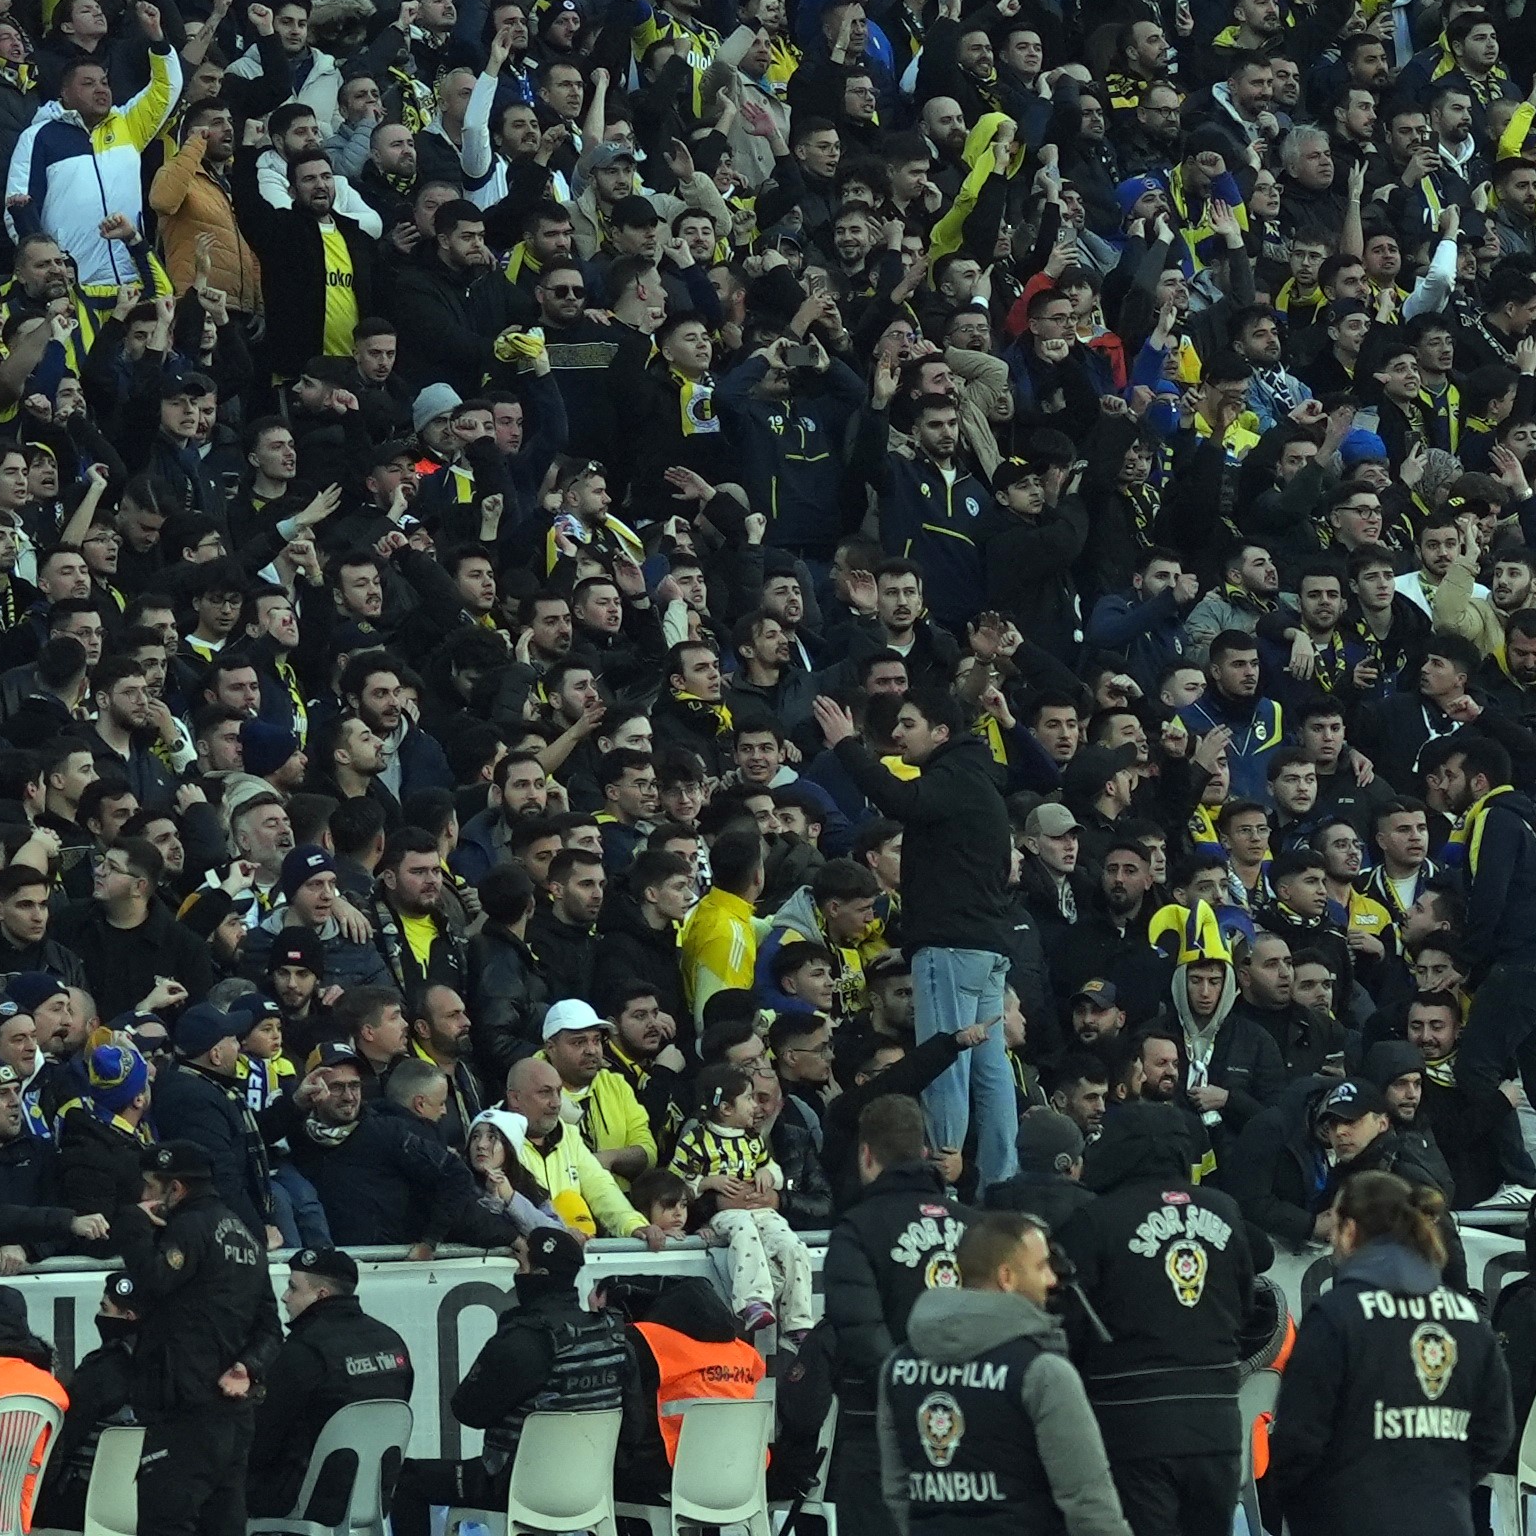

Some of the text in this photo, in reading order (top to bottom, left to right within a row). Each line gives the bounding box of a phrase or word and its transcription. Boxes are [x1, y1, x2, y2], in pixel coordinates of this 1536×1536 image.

[889, 1216, 944, 1269] SPOR
[1127, 1204, 1234, 1259] SPOR ŞUBE
[345, 1355, 379, 1376] ÖZEL
